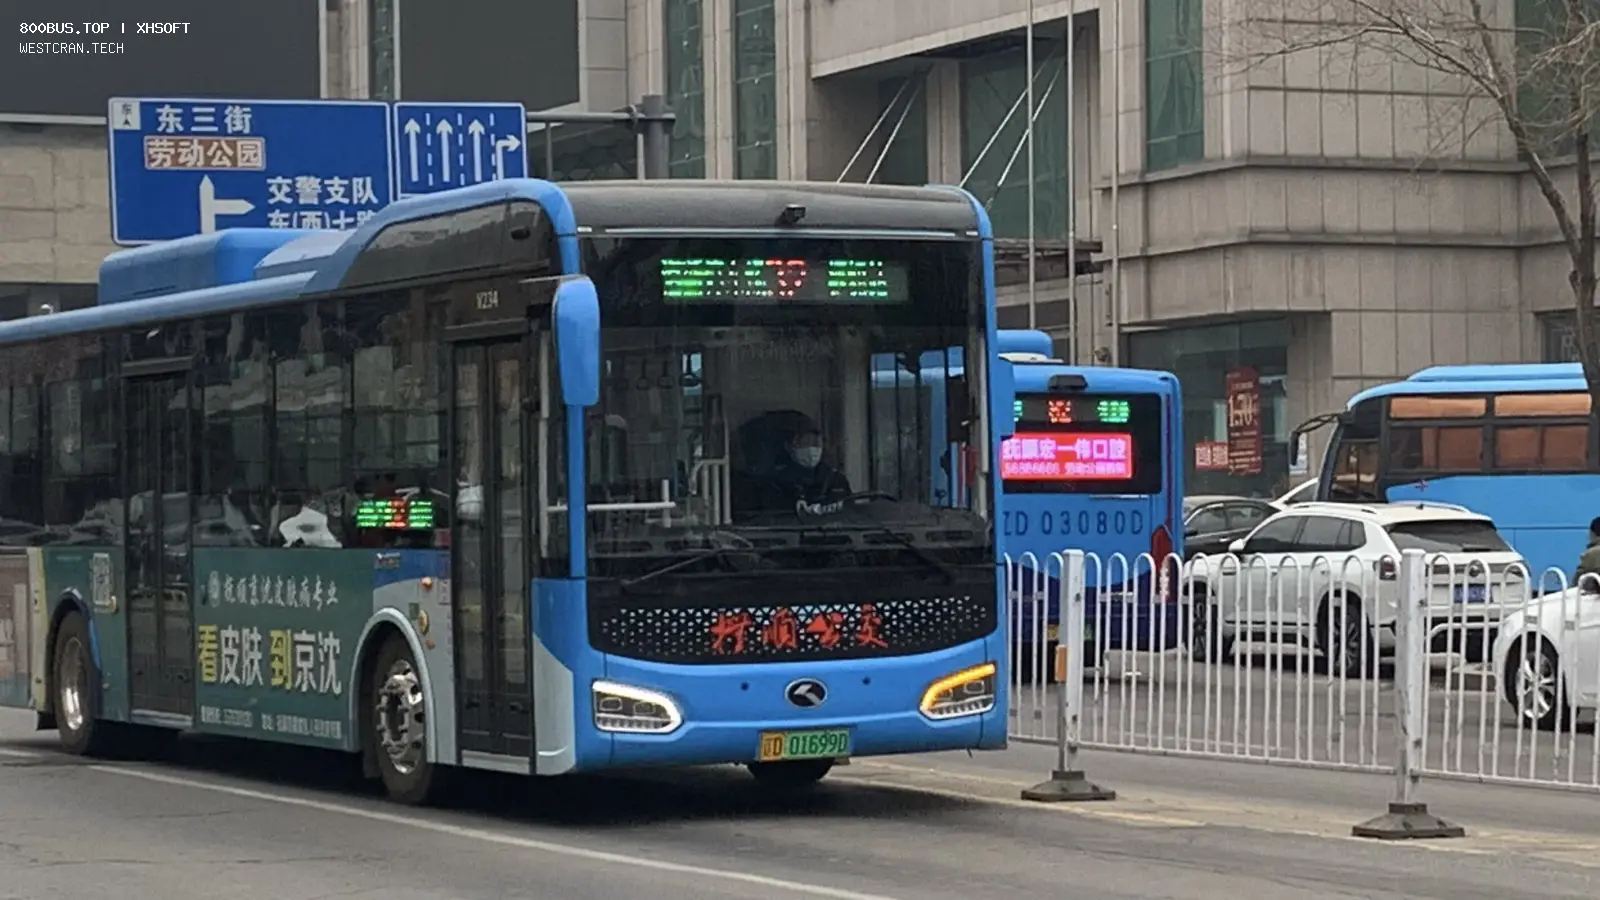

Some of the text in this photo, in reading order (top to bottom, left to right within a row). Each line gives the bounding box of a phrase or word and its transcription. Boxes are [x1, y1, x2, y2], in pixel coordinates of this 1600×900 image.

[156, 104, 253, 134] 东三街
[147, 138, 263, 168] 劳动公园
[266, 176, 379, 205] 交警支队
[1041, 510, 1143, 535] 03080D
[198, 624, 342, 695] 看皮肤 到京沈
